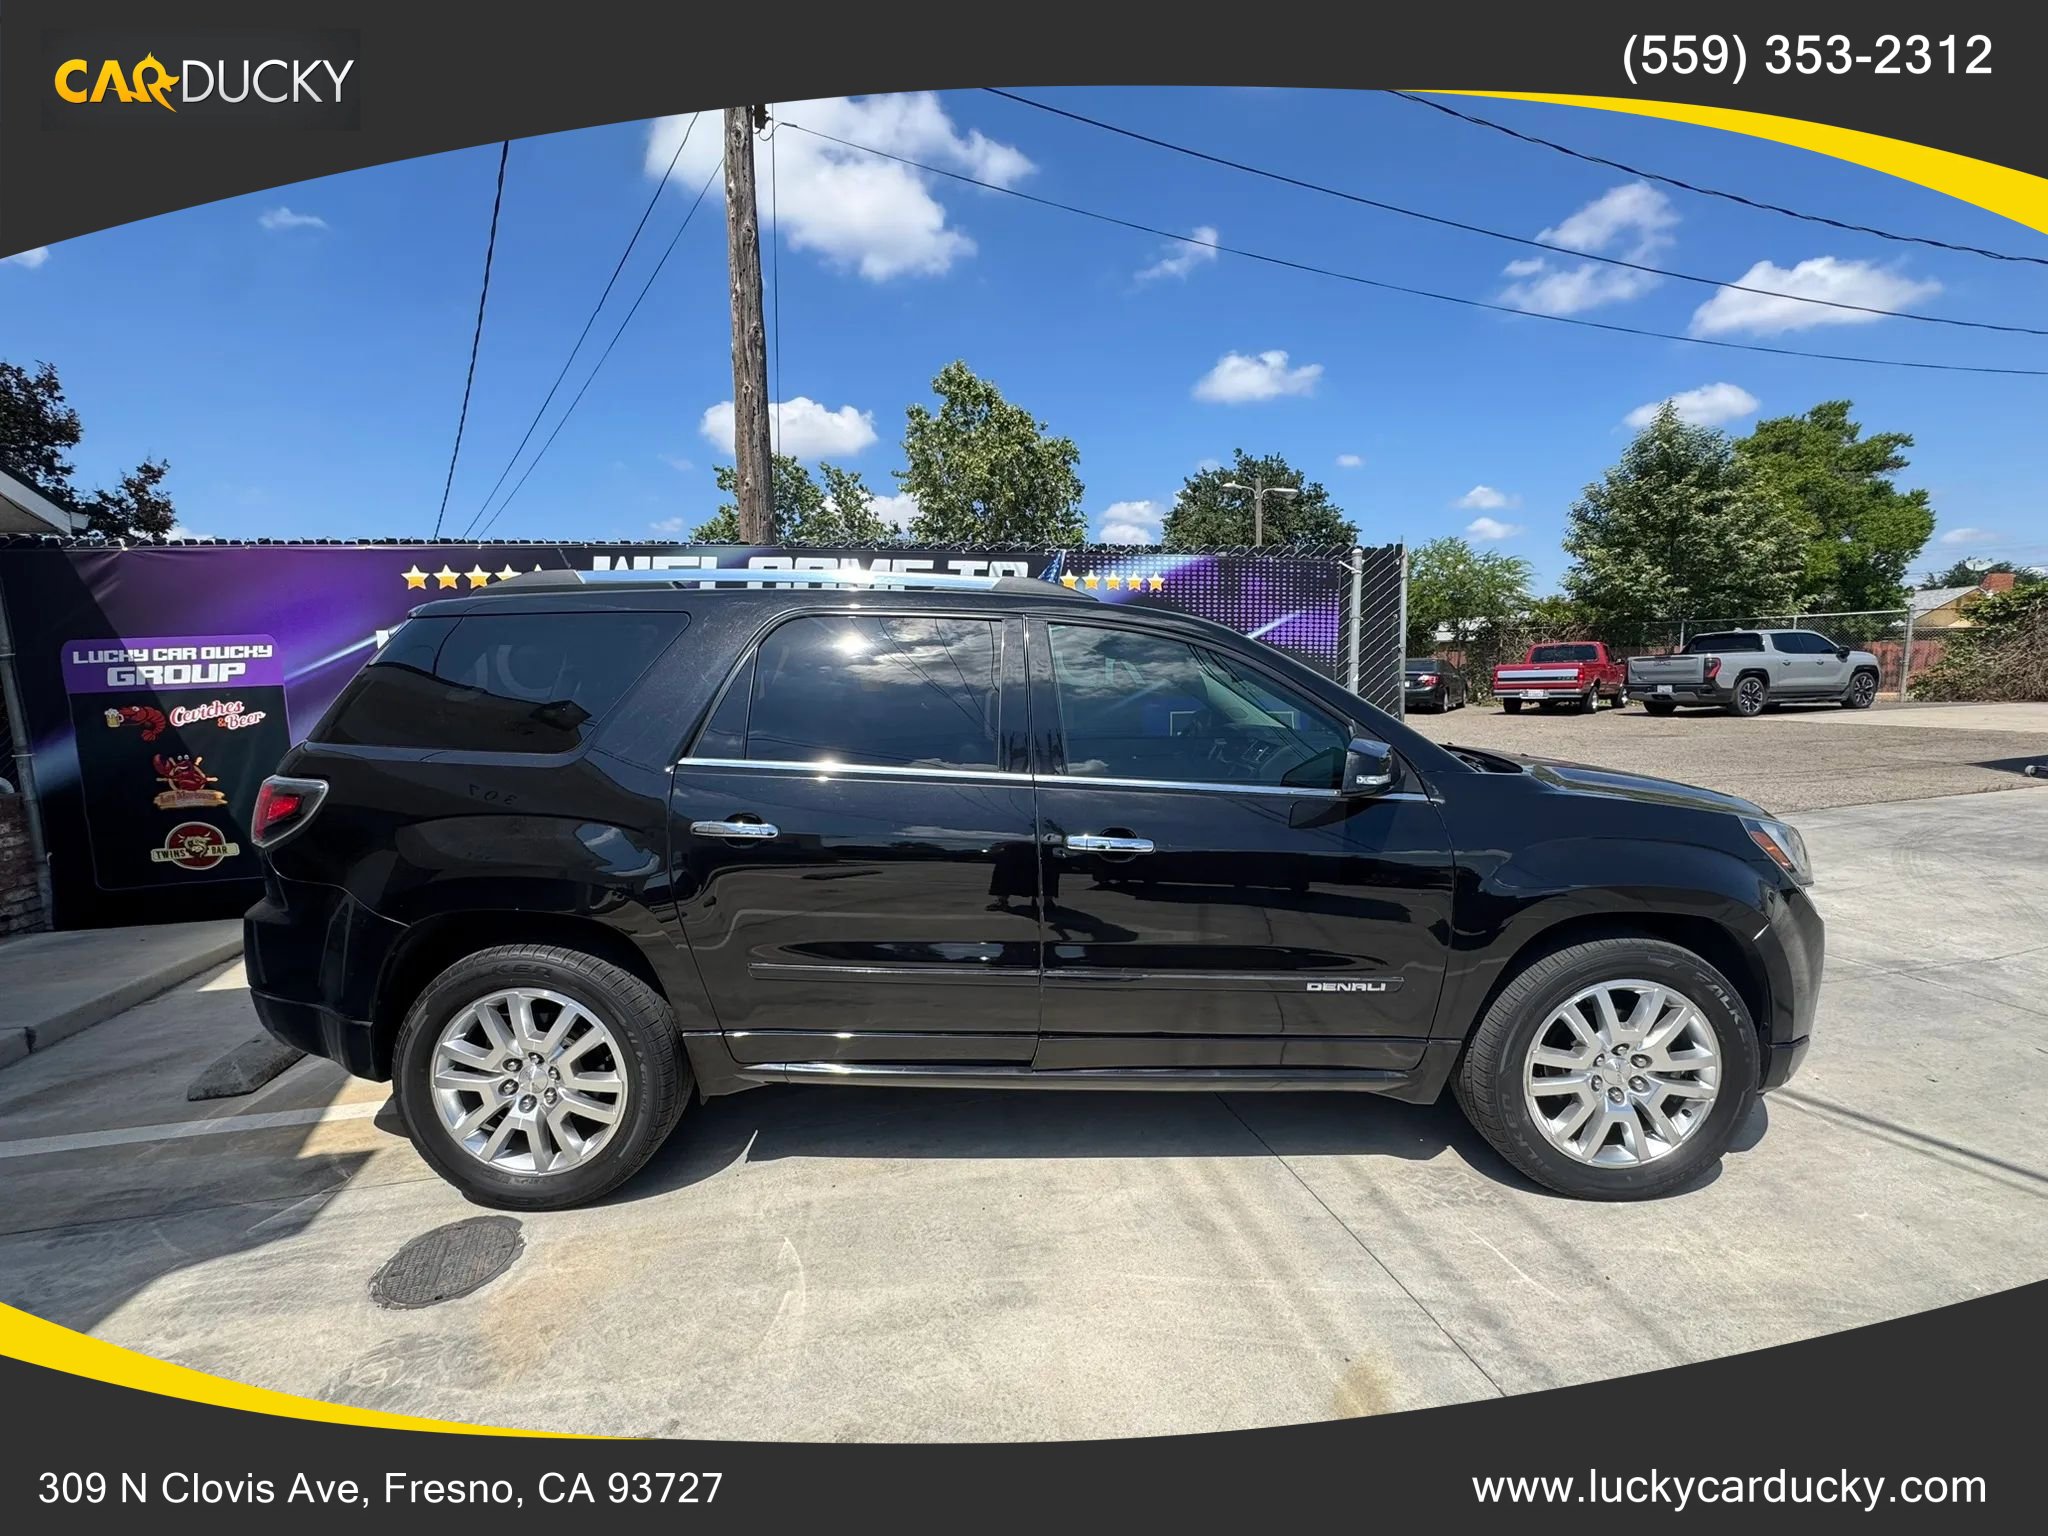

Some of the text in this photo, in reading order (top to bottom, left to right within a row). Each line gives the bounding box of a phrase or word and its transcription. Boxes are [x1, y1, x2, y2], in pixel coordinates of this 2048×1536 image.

[73, 645, 273, 664] LUCKY CAR DUCKY
[107, 662, 246, 687] GROUP
[169, 700, 244, 727] Ceviches
[155, 844, 228, 860] TWINS BAR
[1306, 982, 1387, 992] DENALI
